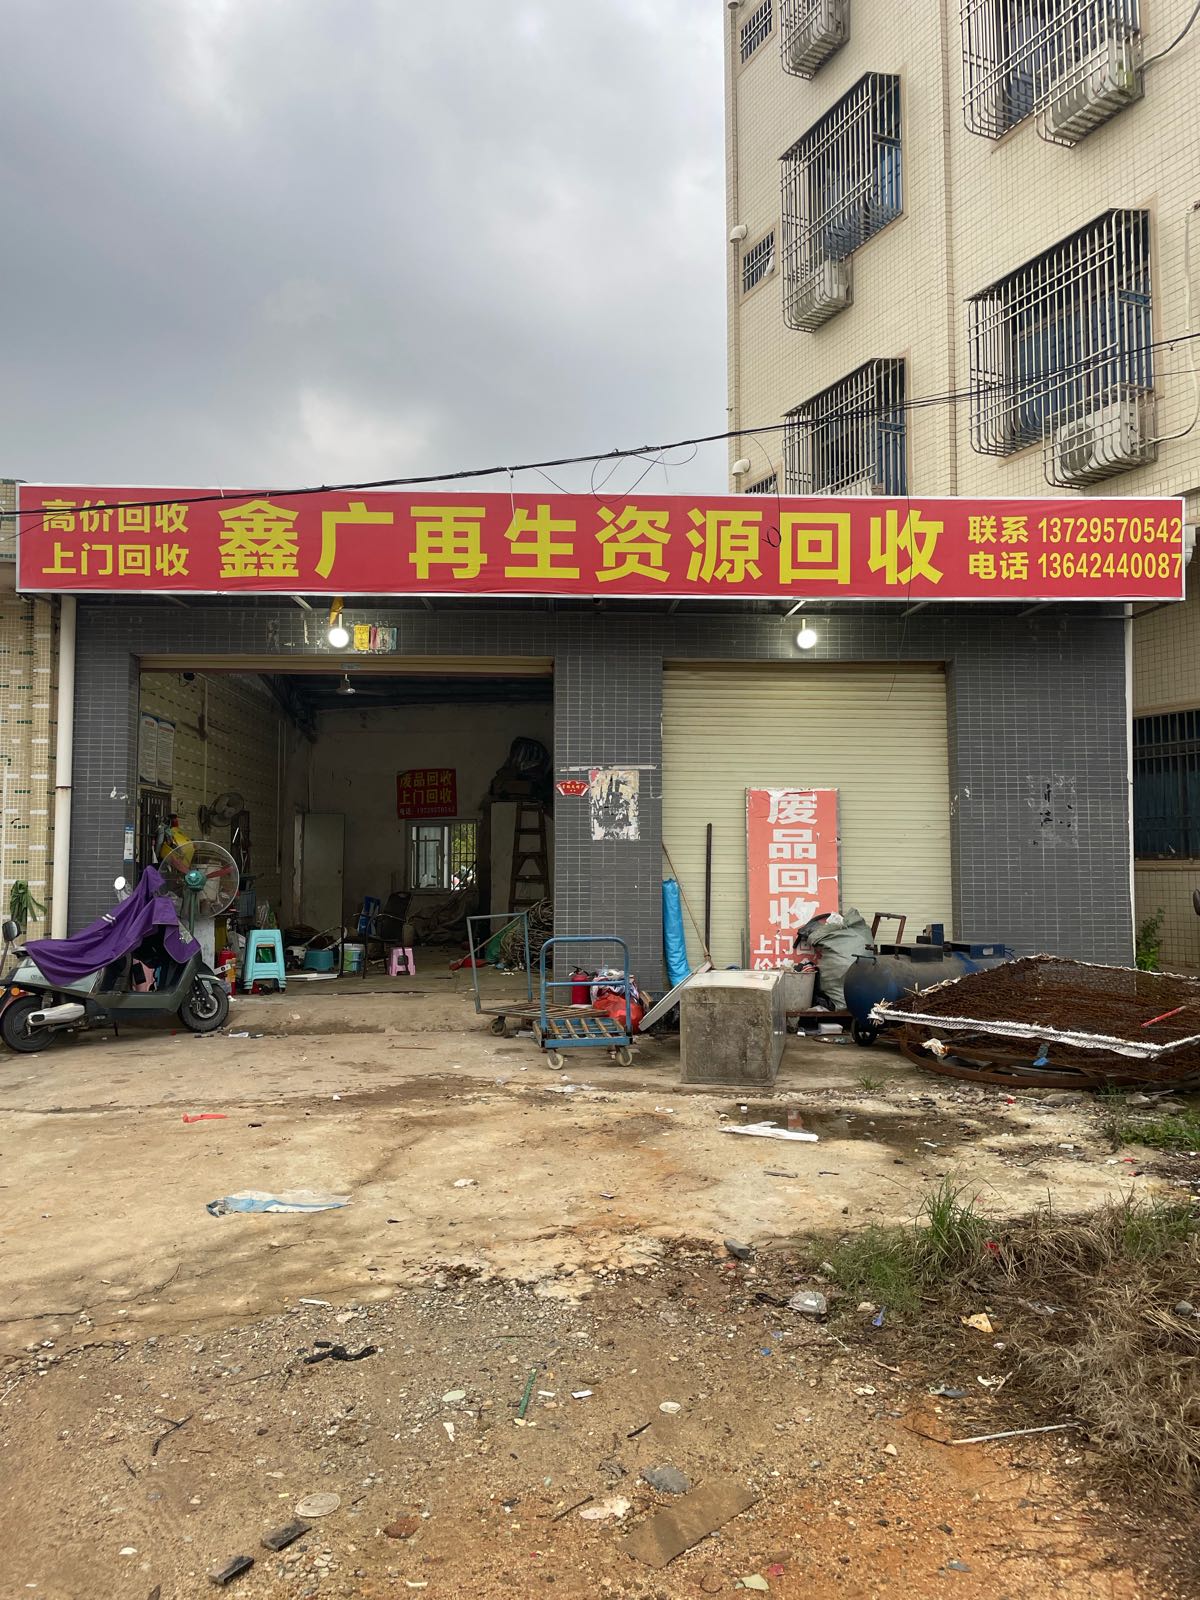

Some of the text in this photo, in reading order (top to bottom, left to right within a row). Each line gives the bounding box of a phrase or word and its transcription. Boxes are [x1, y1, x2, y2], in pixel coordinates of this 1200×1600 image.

[42, 499, 189, 532] 高价回收
[968, 515, 1182, 544] 联系 13729570542
[219, 500, 945, 586] 鑫广再生资源回收
[42, 542, 189, 576] 上门回收
[968, 551, 1182, 580] 电话 13642440087
[400, 770, 452, 788] 废品回收
[400, 788, 452, 805] 上门回收
[767, 791, 820, 929] 废品回收
